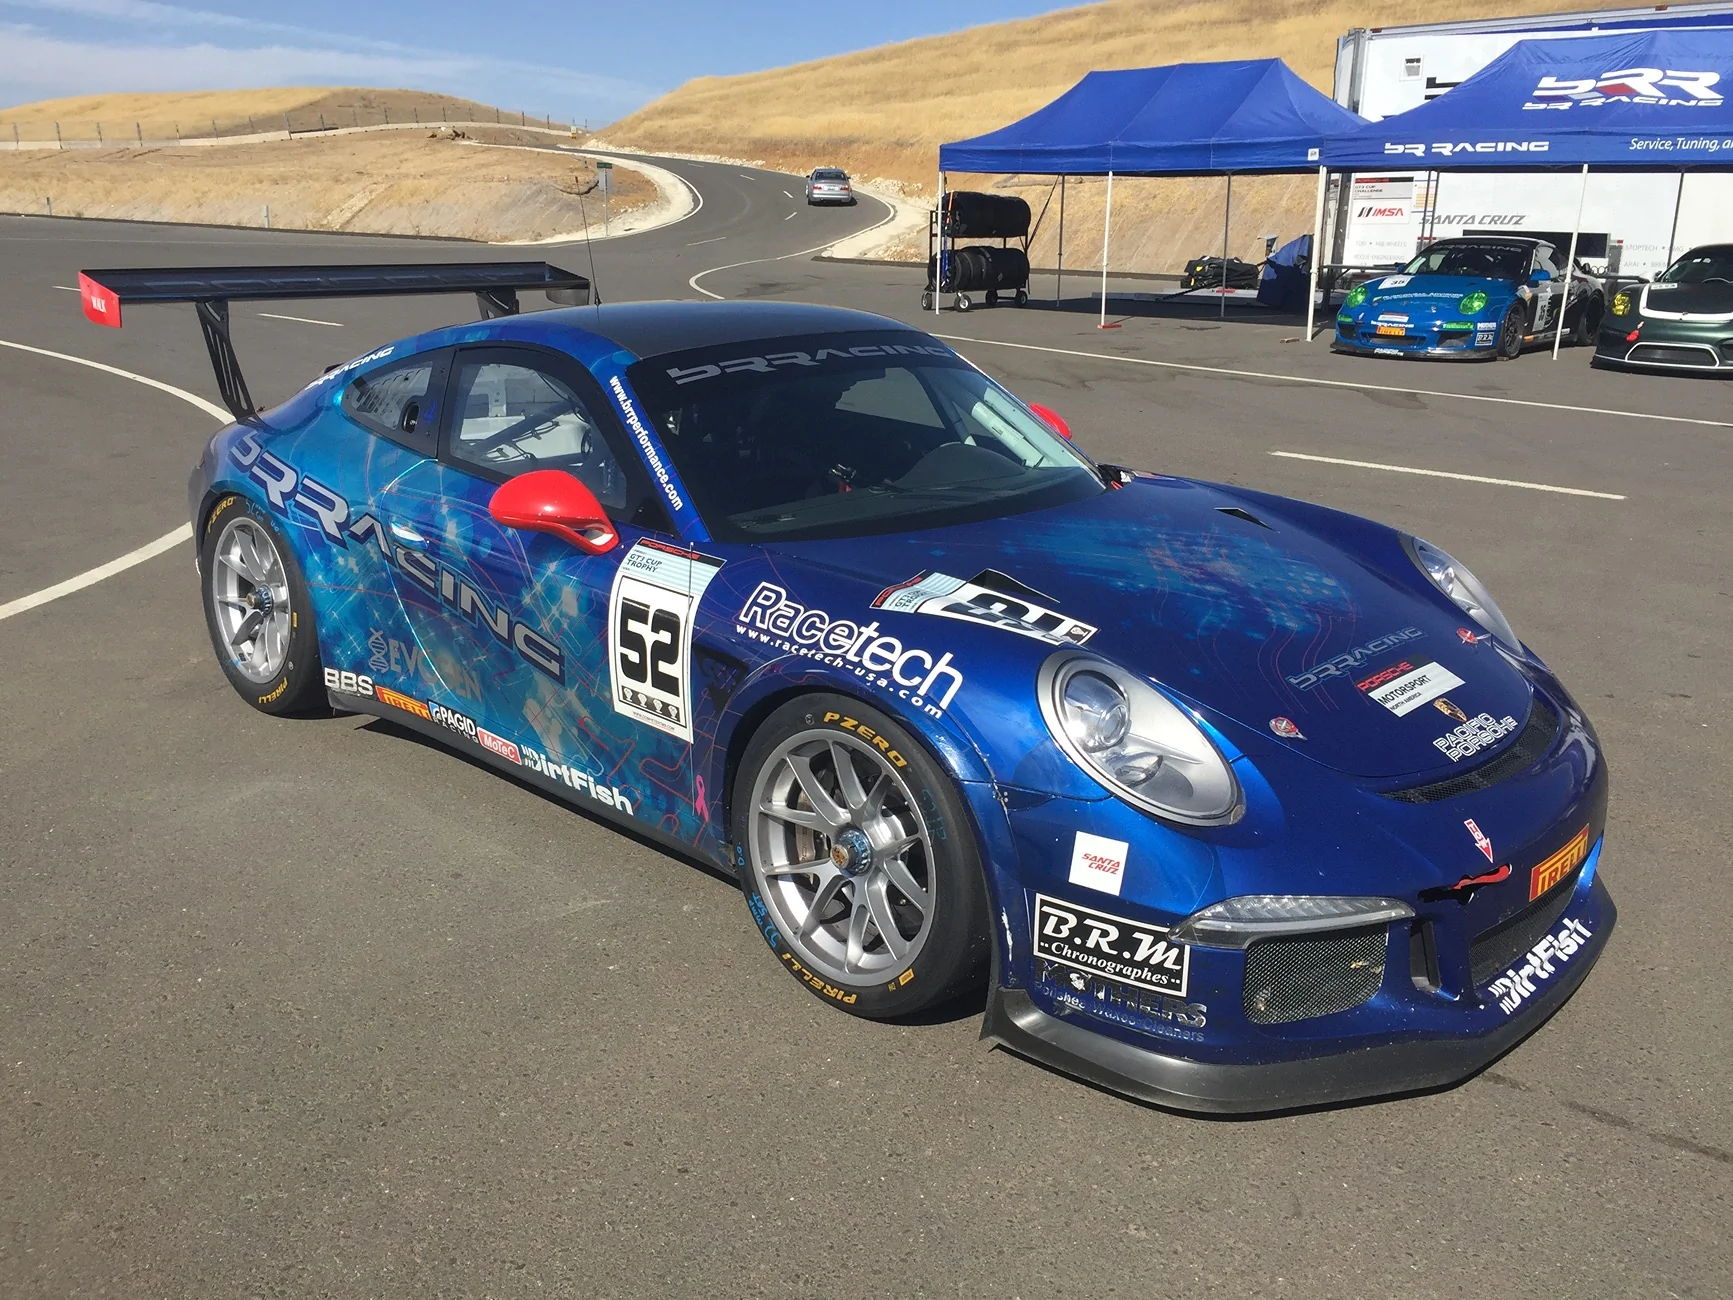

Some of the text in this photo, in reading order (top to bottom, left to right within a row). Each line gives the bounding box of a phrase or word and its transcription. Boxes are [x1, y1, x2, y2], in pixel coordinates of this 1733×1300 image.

[1579, 96, 1723, 107] RACING
[1431, 141, 1549, 156] RACING
[1629, 137, 1673, 152] Service,
[1676, 137, 1720, 152] Tuning,
[1372, 207, 1404, 217] IMSA
[1418, 214, 1528, 225] SANTA CRUZ
[609, 375, 683, 511] www.brrperformance.com
[630, 553, 663, 567] GT3 CUP
[639, 539, 700, 560] PORSCHE
[626, 559, 658, 573] TROPHY
[620, 597, 681, 698] 52
[739, 581, 963, 710] Racetech
[324, 668, 374, 696] BBS
[736, 623, 943, 719] www.racetech-usa.com
[1357, 661, 1415, 692] PORSCHE
[258, 676, 288, 705] PIRELLI
[1378, 674, 1432, 705] MOTORSPORT
[433, 717, 479, 745] RACING
[440, 707, 476, 735] PAGID
[1433, 712, 1496, 753] PACIFIC
[484, 735, 516, 759] MoTeC
[1446, 715, 1518, 763] PORSCHE
[521, 743, 634, 816] DirtFish
[1082, 853, 1121, 868] SANTA
[1088, 861, 1119, 875] CRUZ
[1537, 834, 1588, 897] PIRELLI
[782, 952, 858, 1005] PIRELLI
[1488, 916, 1592, 1015] DirtFish
[1035, 959, 1207, 1028] MOTHERS
[1142, 1019, 1205, 1043] Cleaners
